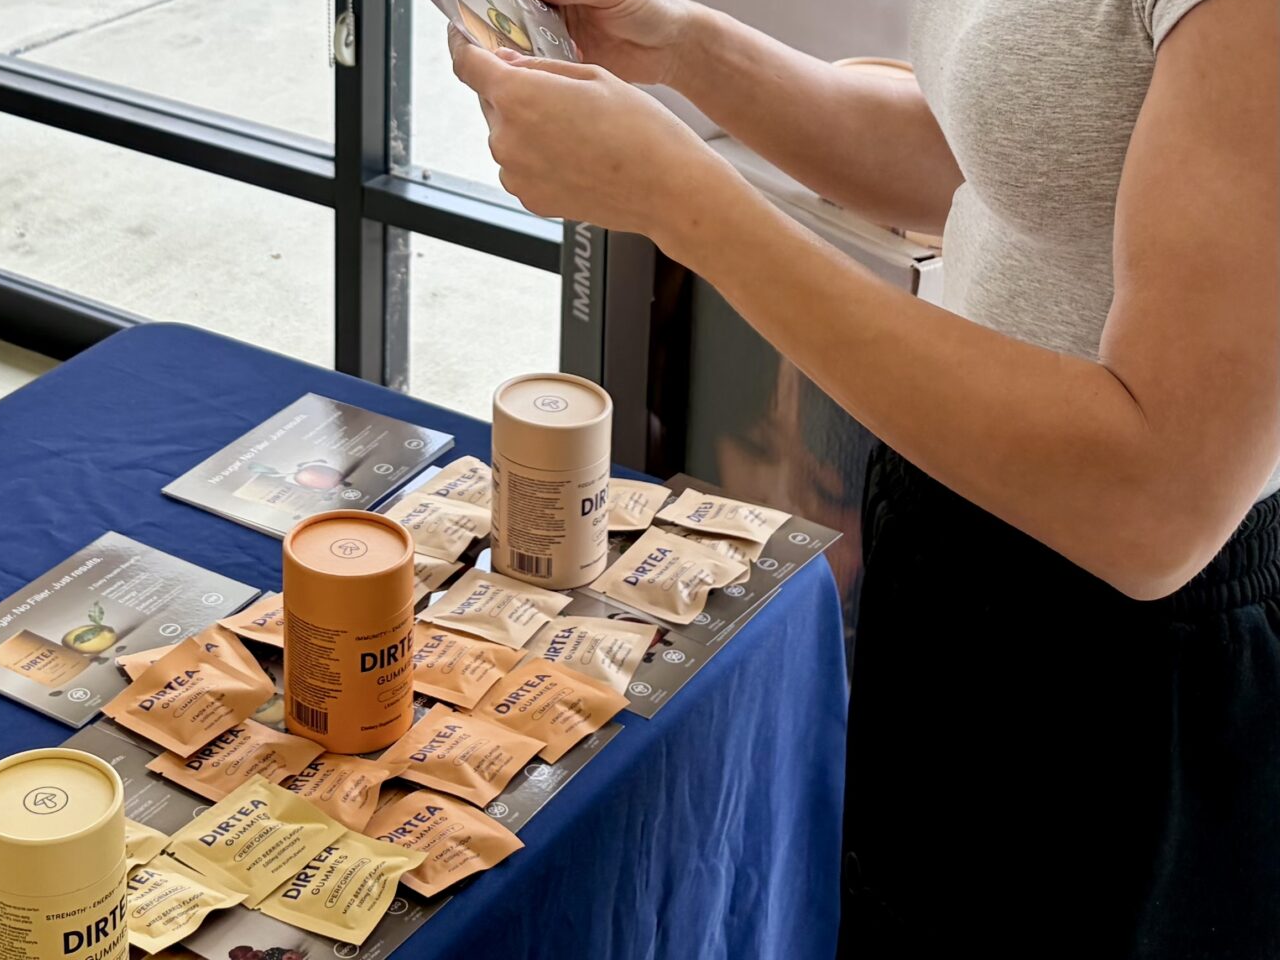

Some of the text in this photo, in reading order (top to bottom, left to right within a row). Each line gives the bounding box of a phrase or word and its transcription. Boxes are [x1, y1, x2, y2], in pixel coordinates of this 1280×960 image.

[435, 467, 479, 497] DIRTEA
[12, 602, 31, 615] No
[52, 575, 74, 590] Just
[70, 556, 103, 578] results.
[623, 546, 673, 587] DIRTEA
[450, 584, 492, 616] DIRTEA
[21, 648, 56, 671] DIRTEA
[138, 668, 201, 712] DIRTEA
[494, 674, 552, 715] DIRTEA
[518, 682, 558, 713] GUMMIES
[185, 727, 246, 771] DIRTEA
[409, 724, 463, 763] DIRTEA
[198, 799, 268, 847] DIRTEA
[225, 812, 271, 847] GUMMIES
[376, 805, 444, 843] DIRTEA
[246, 856, 263, 871] MIXED
[262, 840, 284, 859] BERRIES
[282, 845, 340, 900] DIRTEA
[311, 854, 349, 896] GUMMIES
[329, 859, 366, 904] PERFORMANCE
[46, 889, 115, 921] STRENGTH ENERGY
